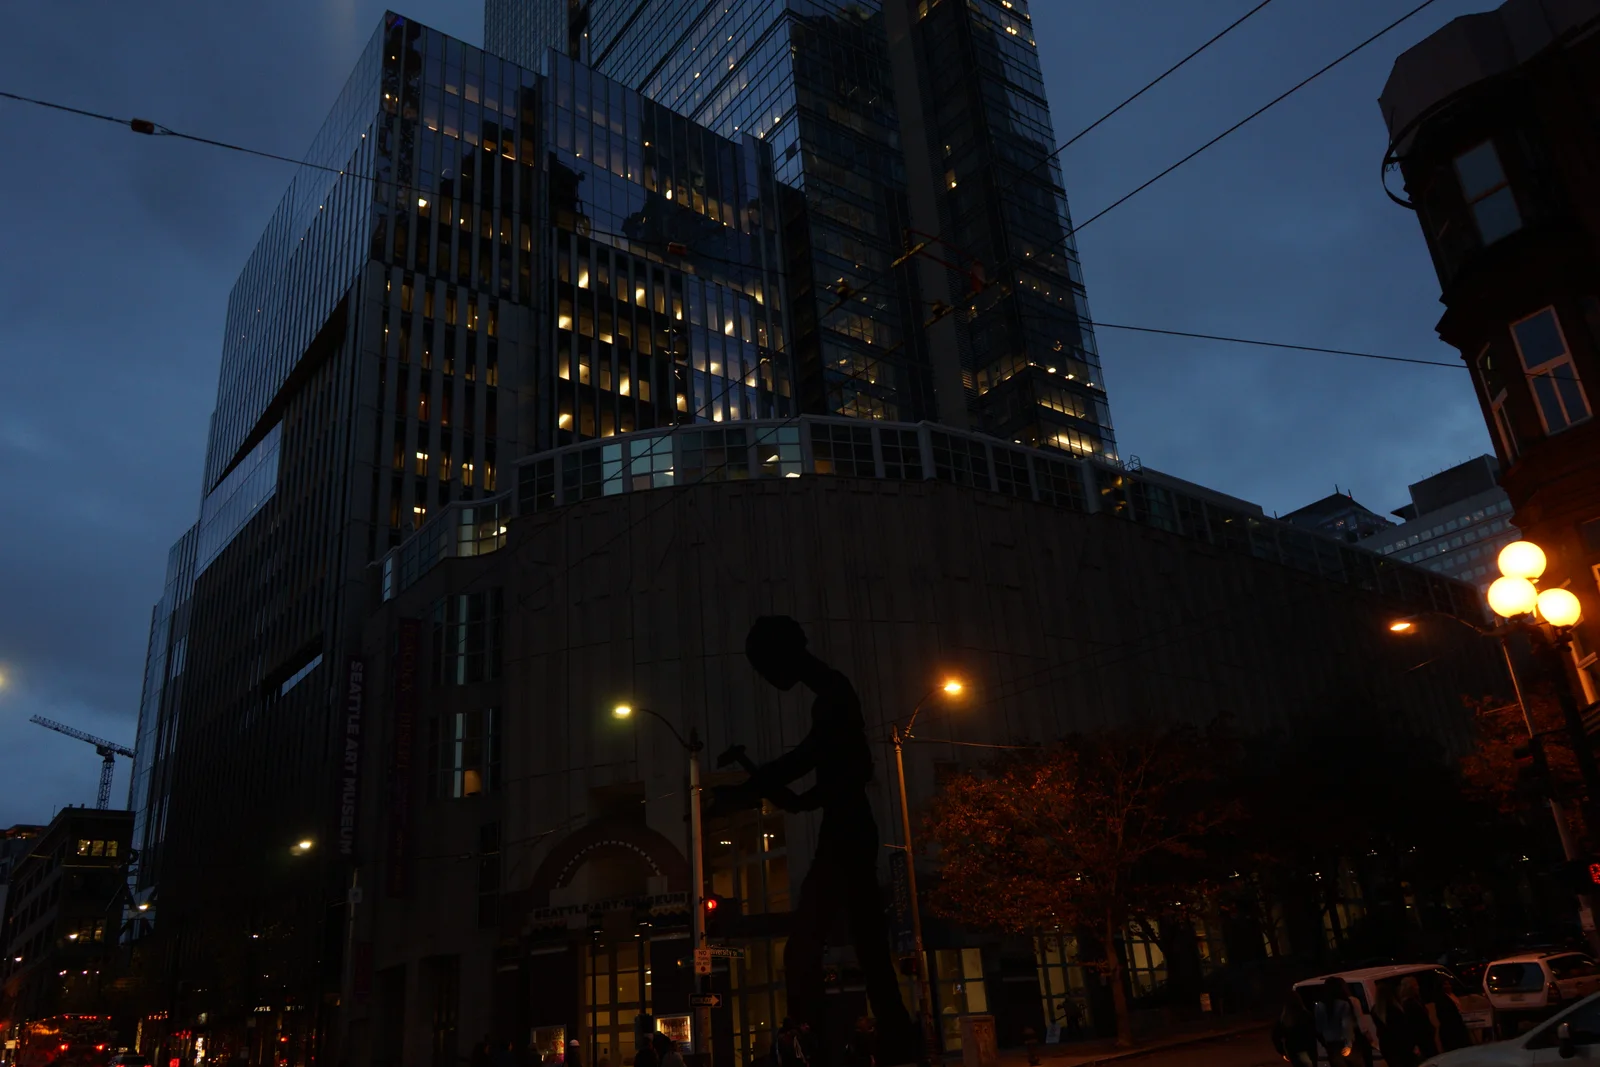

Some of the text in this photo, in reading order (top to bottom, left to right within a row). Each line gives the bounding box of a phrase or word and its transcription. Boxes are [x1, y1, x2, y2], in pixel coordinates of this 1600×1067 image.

[400, 623, 416, 692] PEACOCK
[339, 660, 364, 855] SEATTLE ART MUSEUM
[534, 903, 589, 919] SEATTLE
